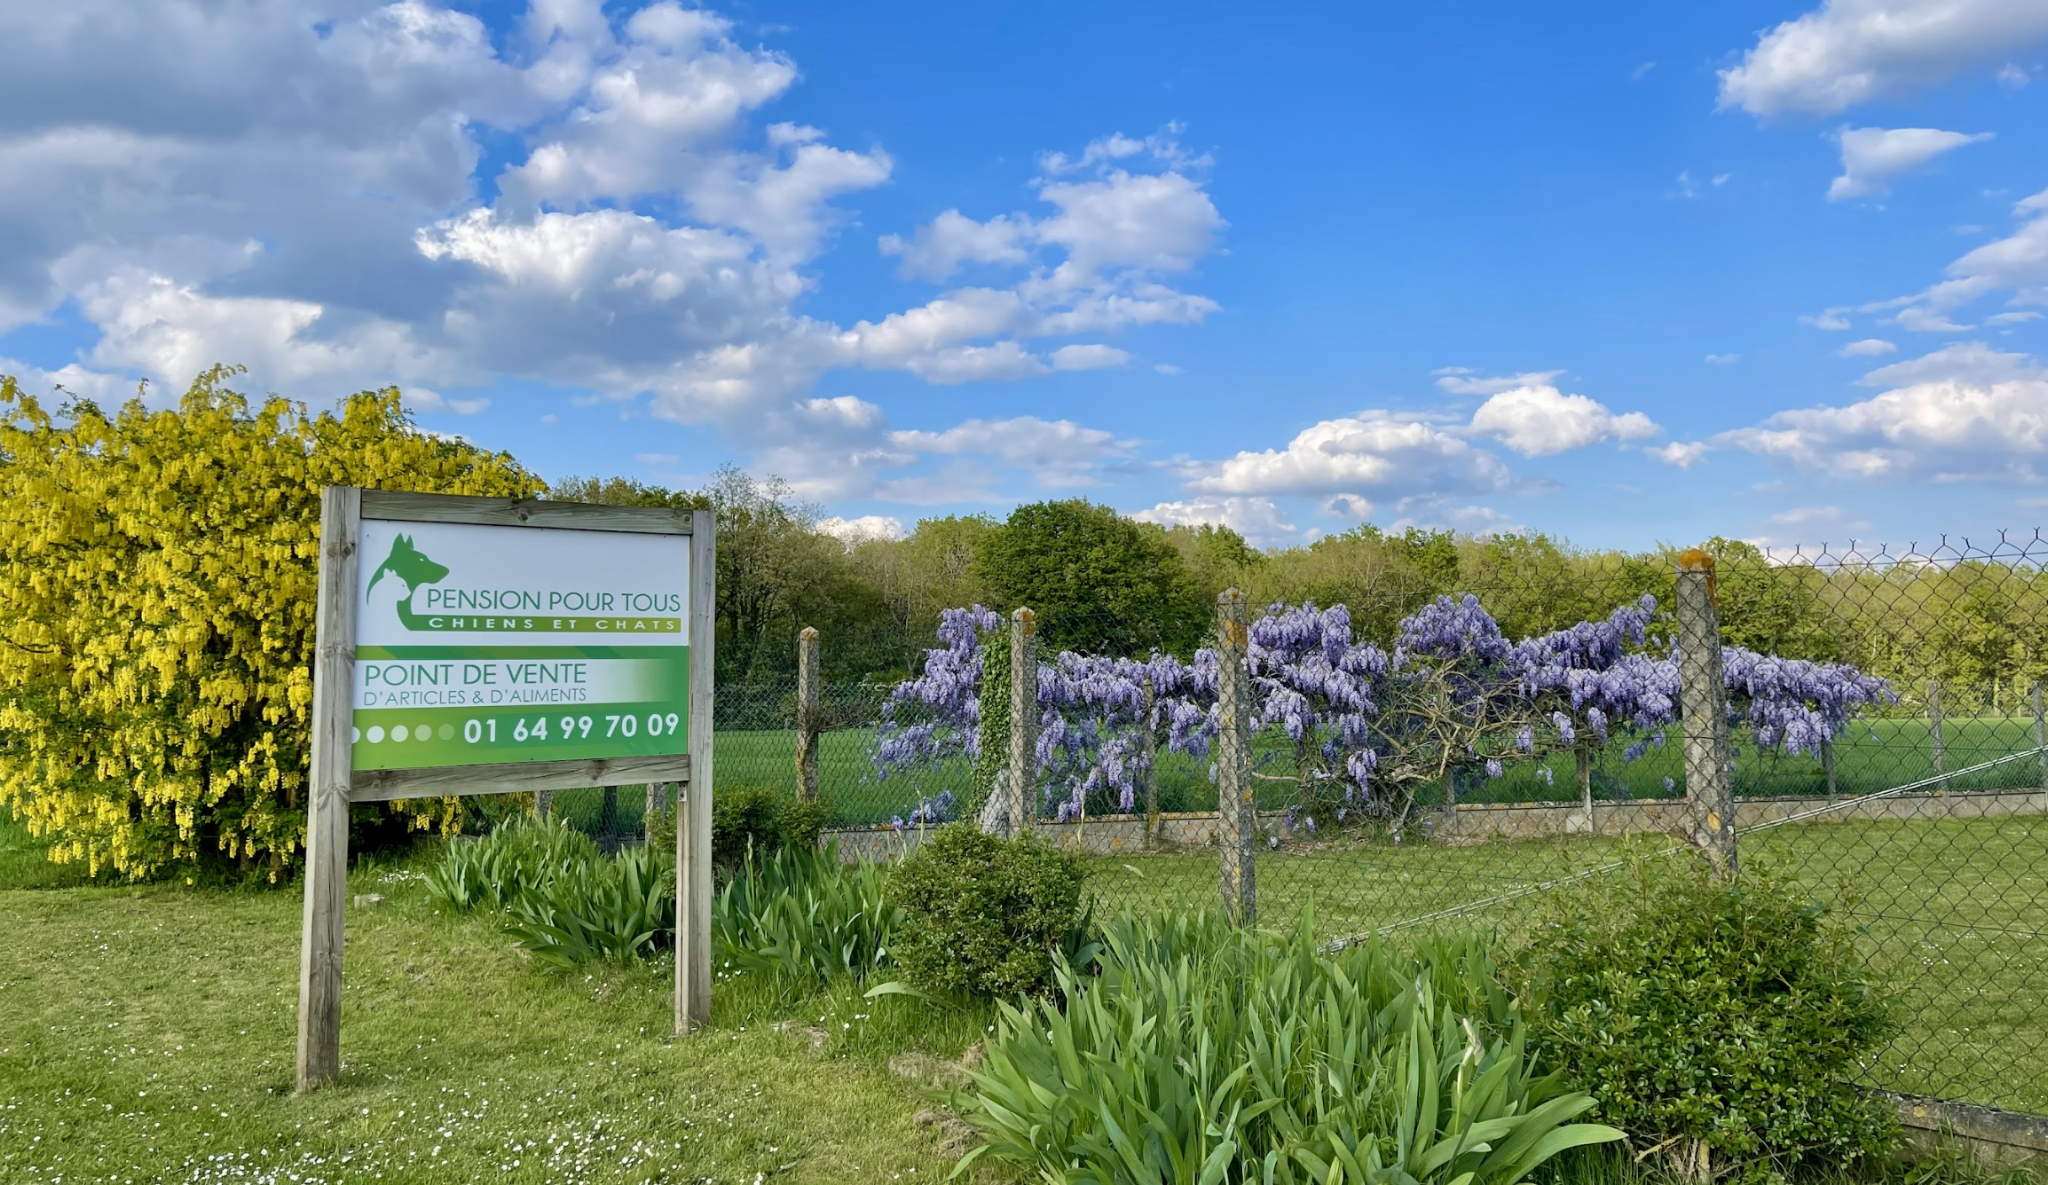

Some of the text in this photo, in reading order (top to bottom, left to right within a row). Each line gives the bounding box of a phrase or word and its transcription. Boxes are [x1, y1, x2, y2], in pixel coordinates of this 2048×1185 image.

[427, 588, 681, 612] PENSION POUR TOUS
[428, 617, 675, 630] CHIENS ET CHATS
[365, 663, 587, 687] POINT DE VENTE
[364, 687, 587, 706] D'ARTICLES & D'ALIMENTS
[464, 713, 679, 744] 01 64 99 70 09
